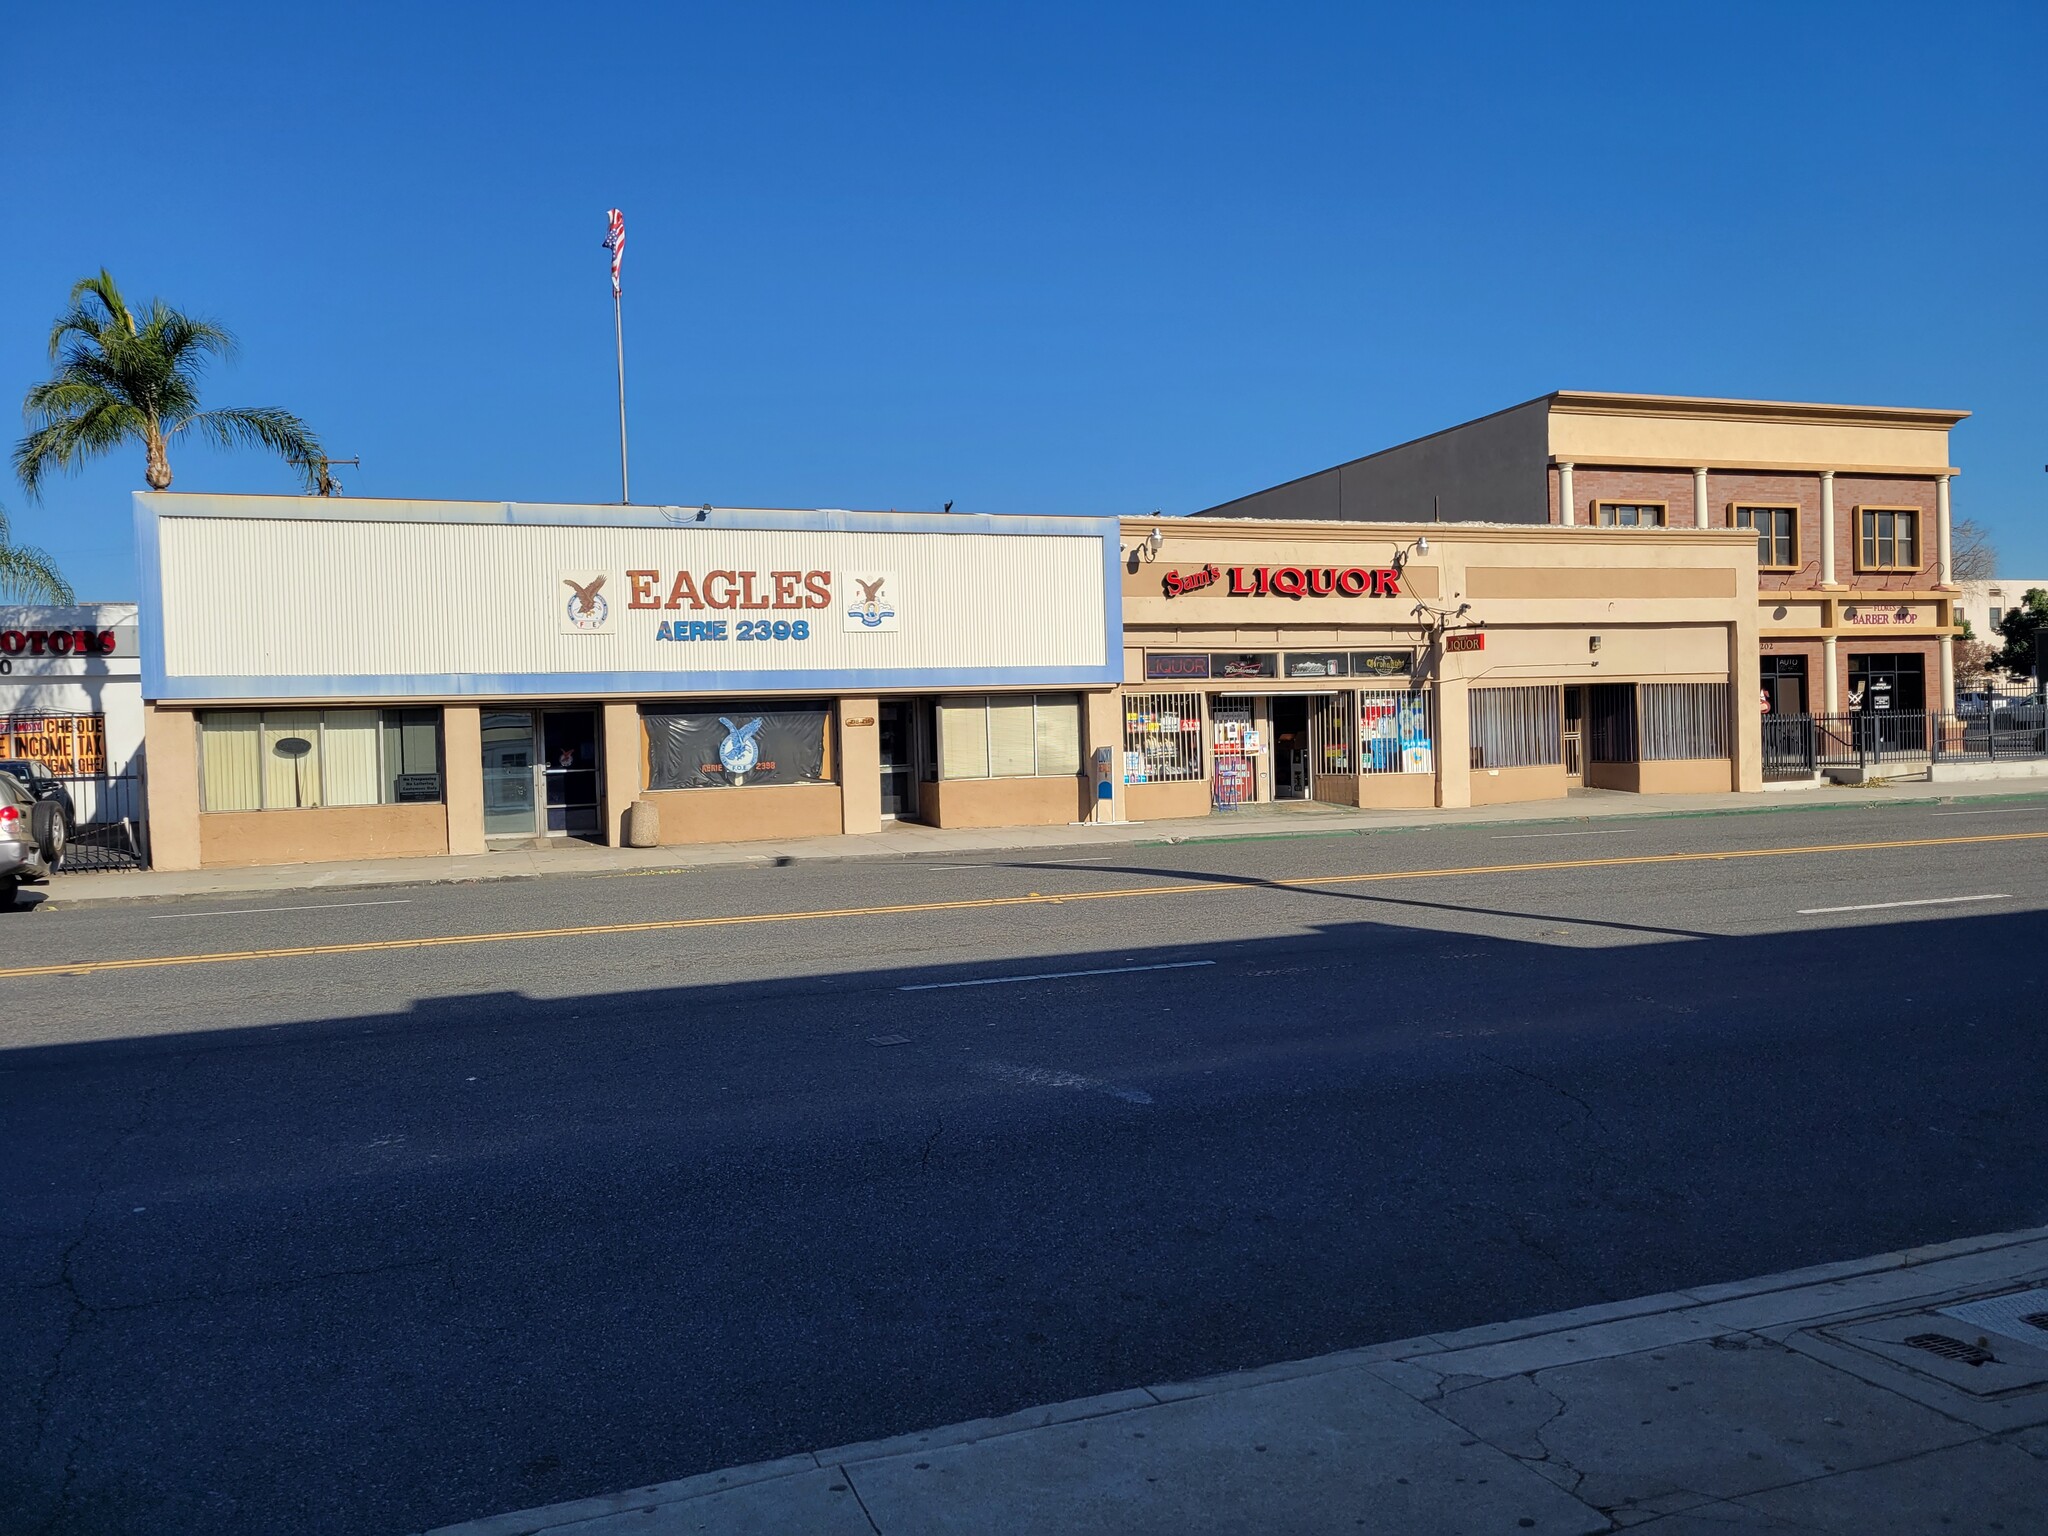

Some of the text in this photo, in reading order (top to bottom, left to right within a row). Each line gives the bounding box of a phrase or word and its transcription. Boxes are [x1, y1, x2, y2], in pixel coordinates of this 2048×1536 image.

[1166, 563, 1401, 596] Sam's LIQUOR
[626, 570, 831, 609] EAGLES
[1853, 614, 1917, 624] BARBER SHOP
[656, 620, 810, 641] AERIE 2398
[0, 630, 116, 655] OTORS
[1447, 640, 1479, 650] LIQUOR
[1147, 659, 1206, 674] LIQUOR
[1224, 665, 1259, 674] Budweiser
[15, 736, 71, 757] INCOME
[77, 735, 102, 756] TAX
[702, 764, 723, 772] AERIE
[755, 762, 776, 770] 2398
